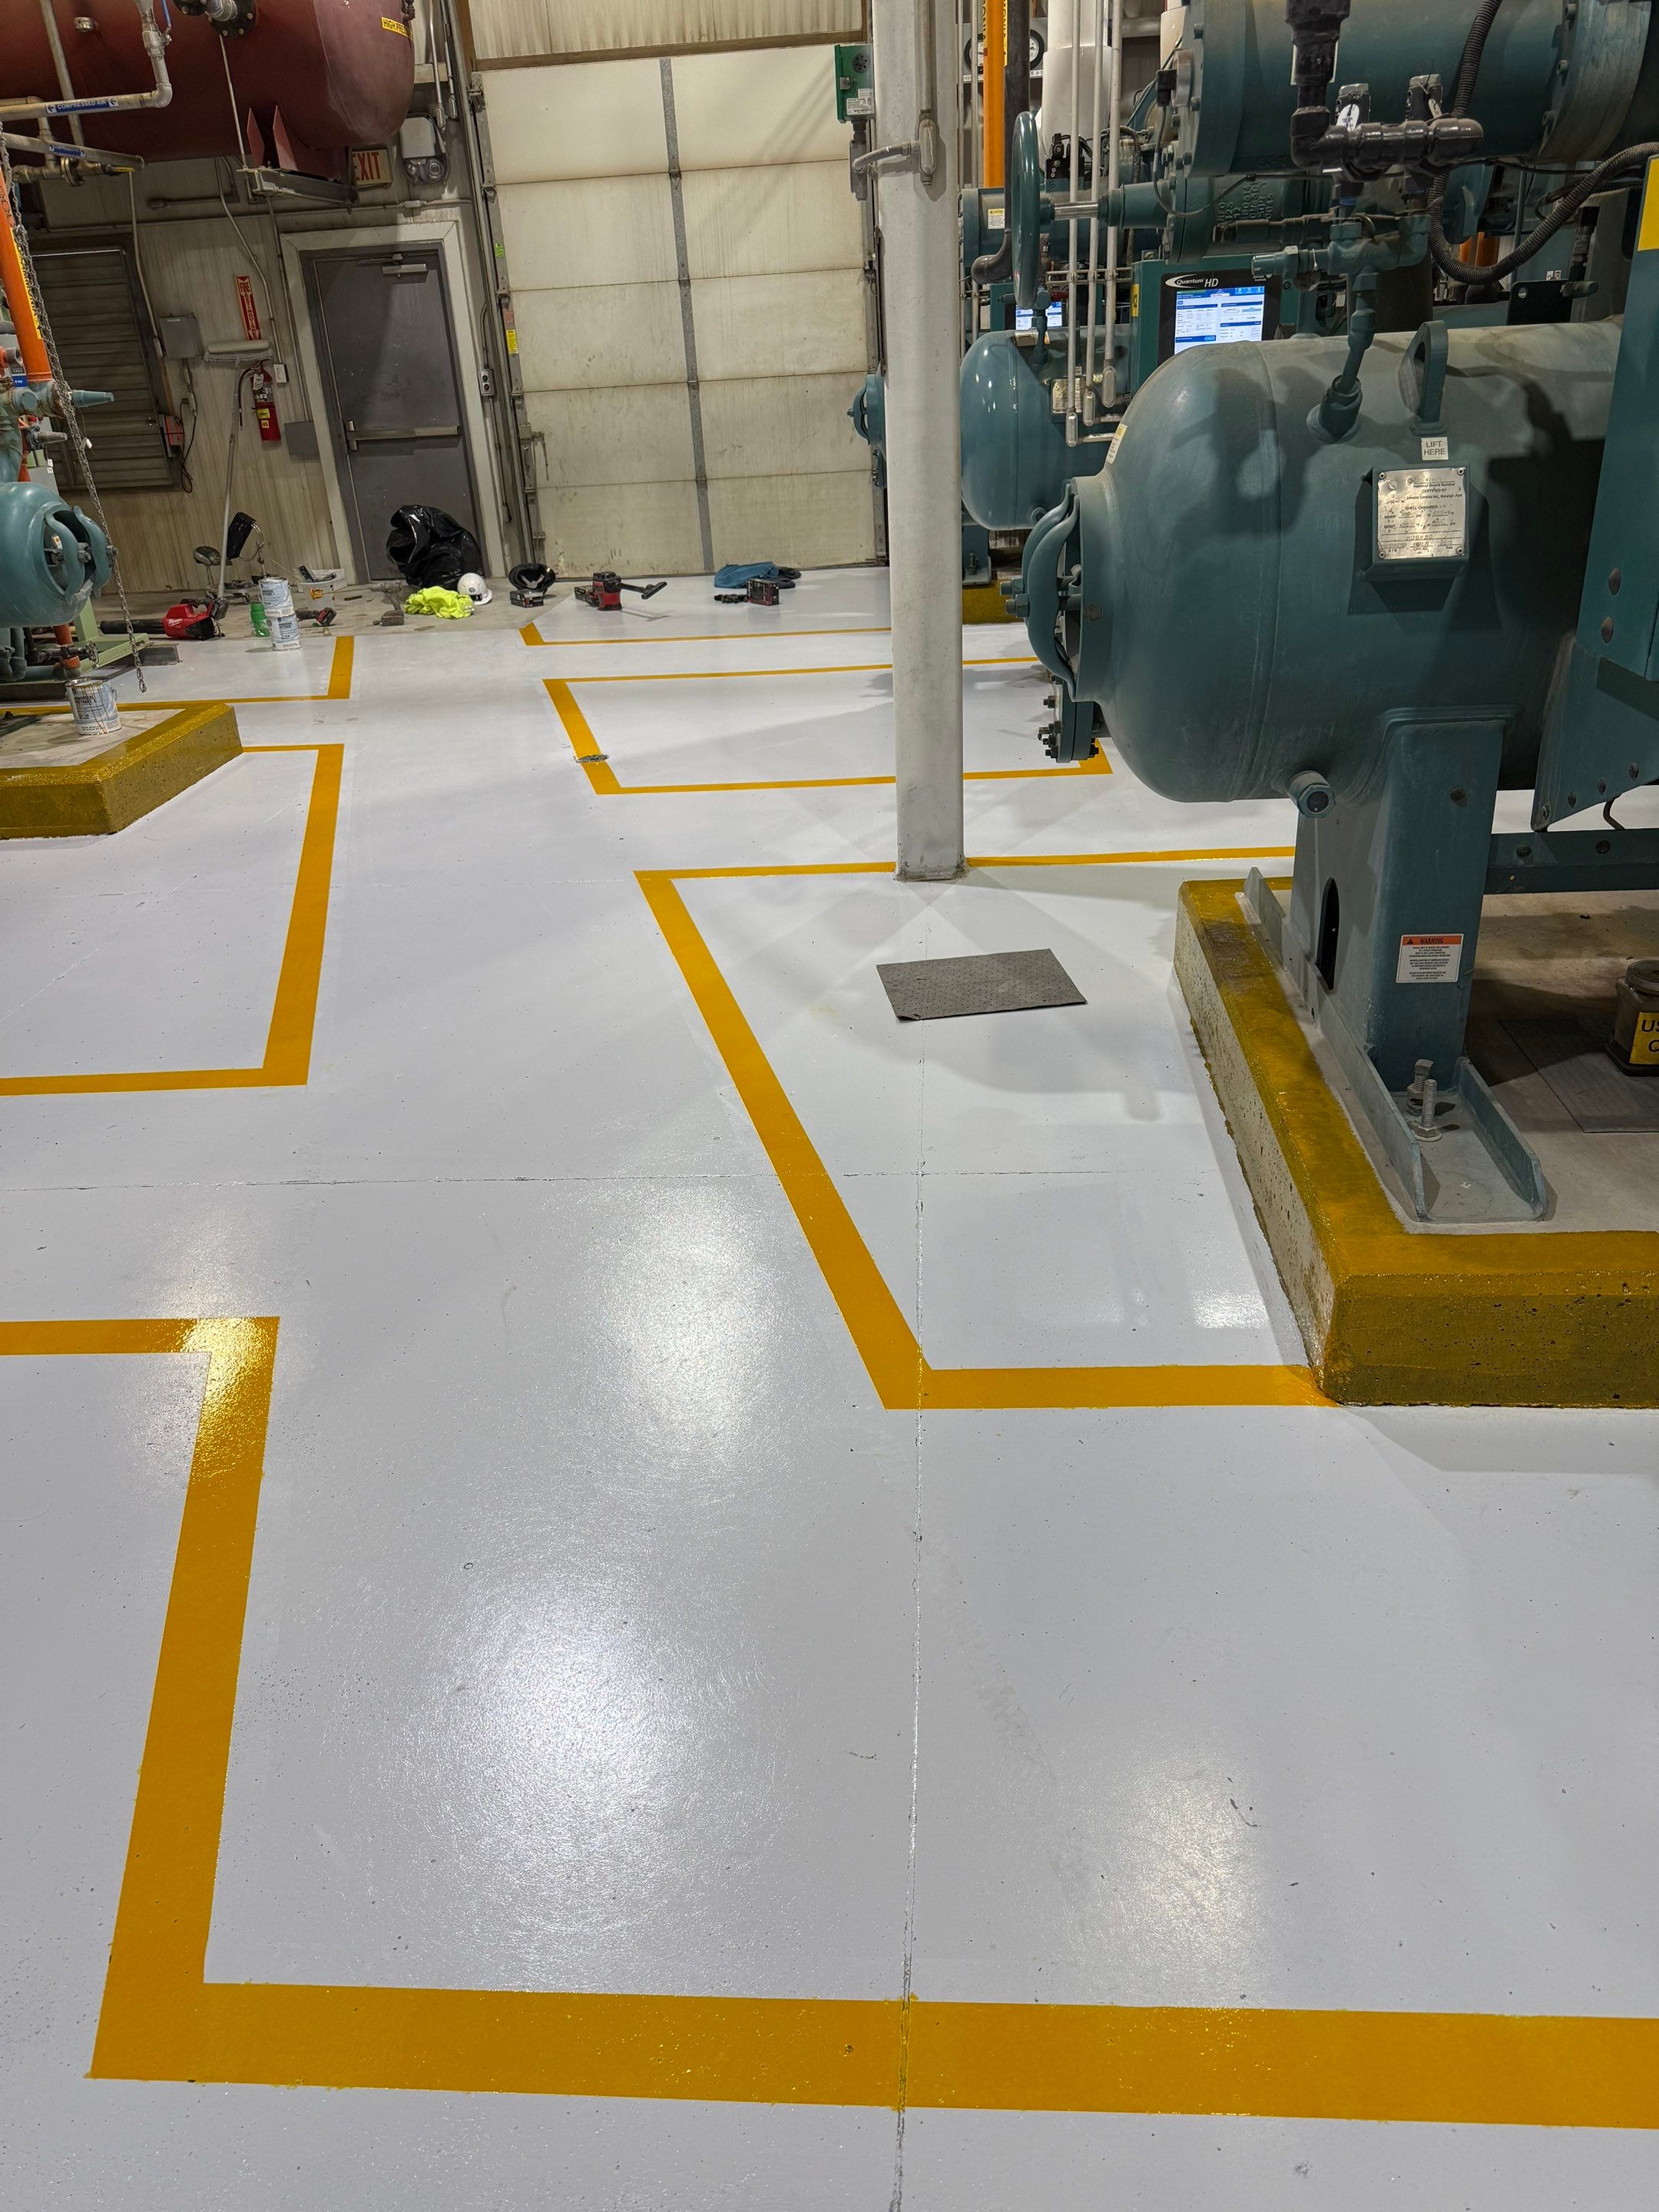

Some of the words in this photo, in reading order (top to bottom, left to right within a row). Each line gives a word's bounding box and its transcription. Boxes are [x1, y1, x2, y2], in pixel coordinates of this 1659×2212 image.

[58, 101, 96, 110] COMPRESSED
[1176, 277, 1204, 286] Quantum
[1204, 278, 1219, 287] HD
[240, 282, 250, 293] FIRE
